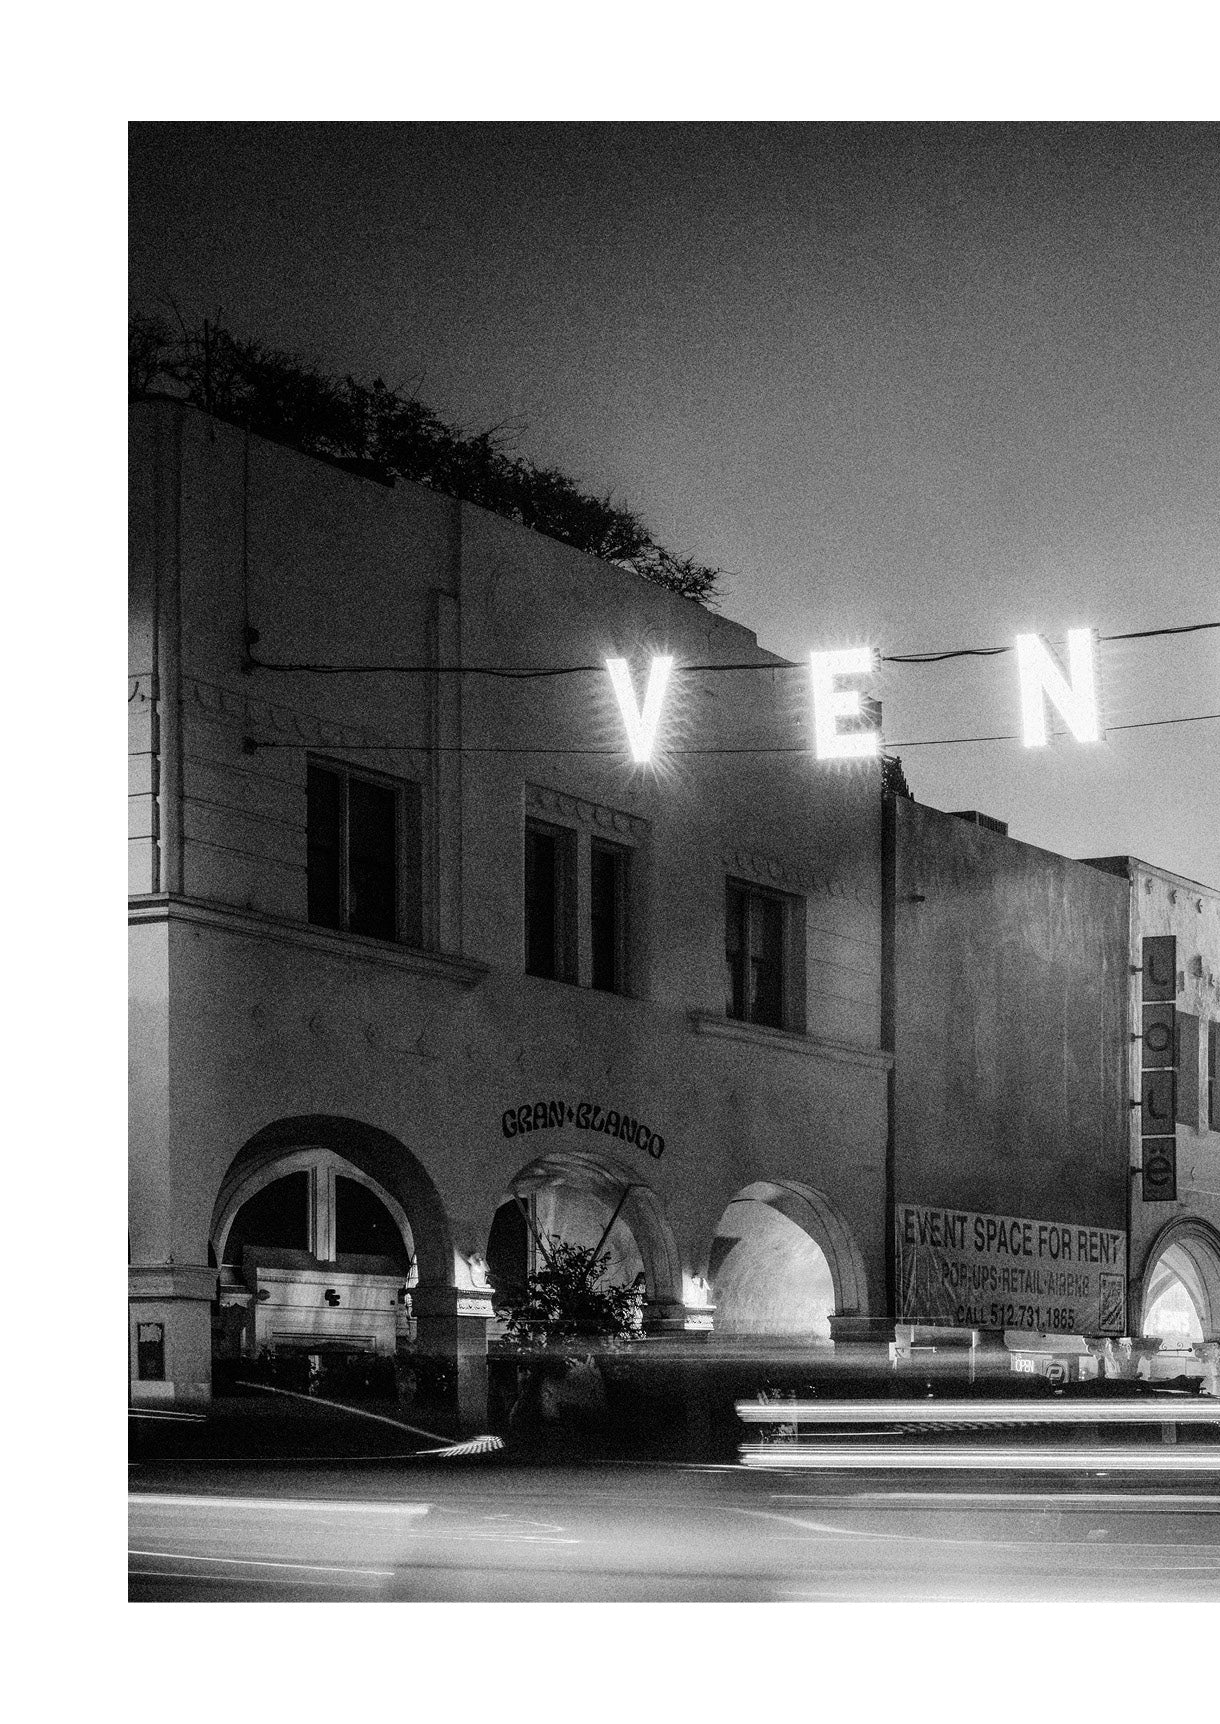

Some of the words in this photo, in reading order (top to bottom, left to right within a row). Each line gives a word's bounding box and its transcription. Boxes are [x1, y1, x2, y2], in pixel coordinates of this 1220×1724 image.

[502, 1100, 565, 1138] GRAN
[575, 1102, 665, 1159] BLANCO
[904, 1208, 968, 1249] EVENT
[973, 1216, 1033, 1256] SPACE
[1038, 1225, 1072, 1261] FOR
[1077, 1230, 1120, 1264] RENT
[956, 1304, 987, 1324] CALL
